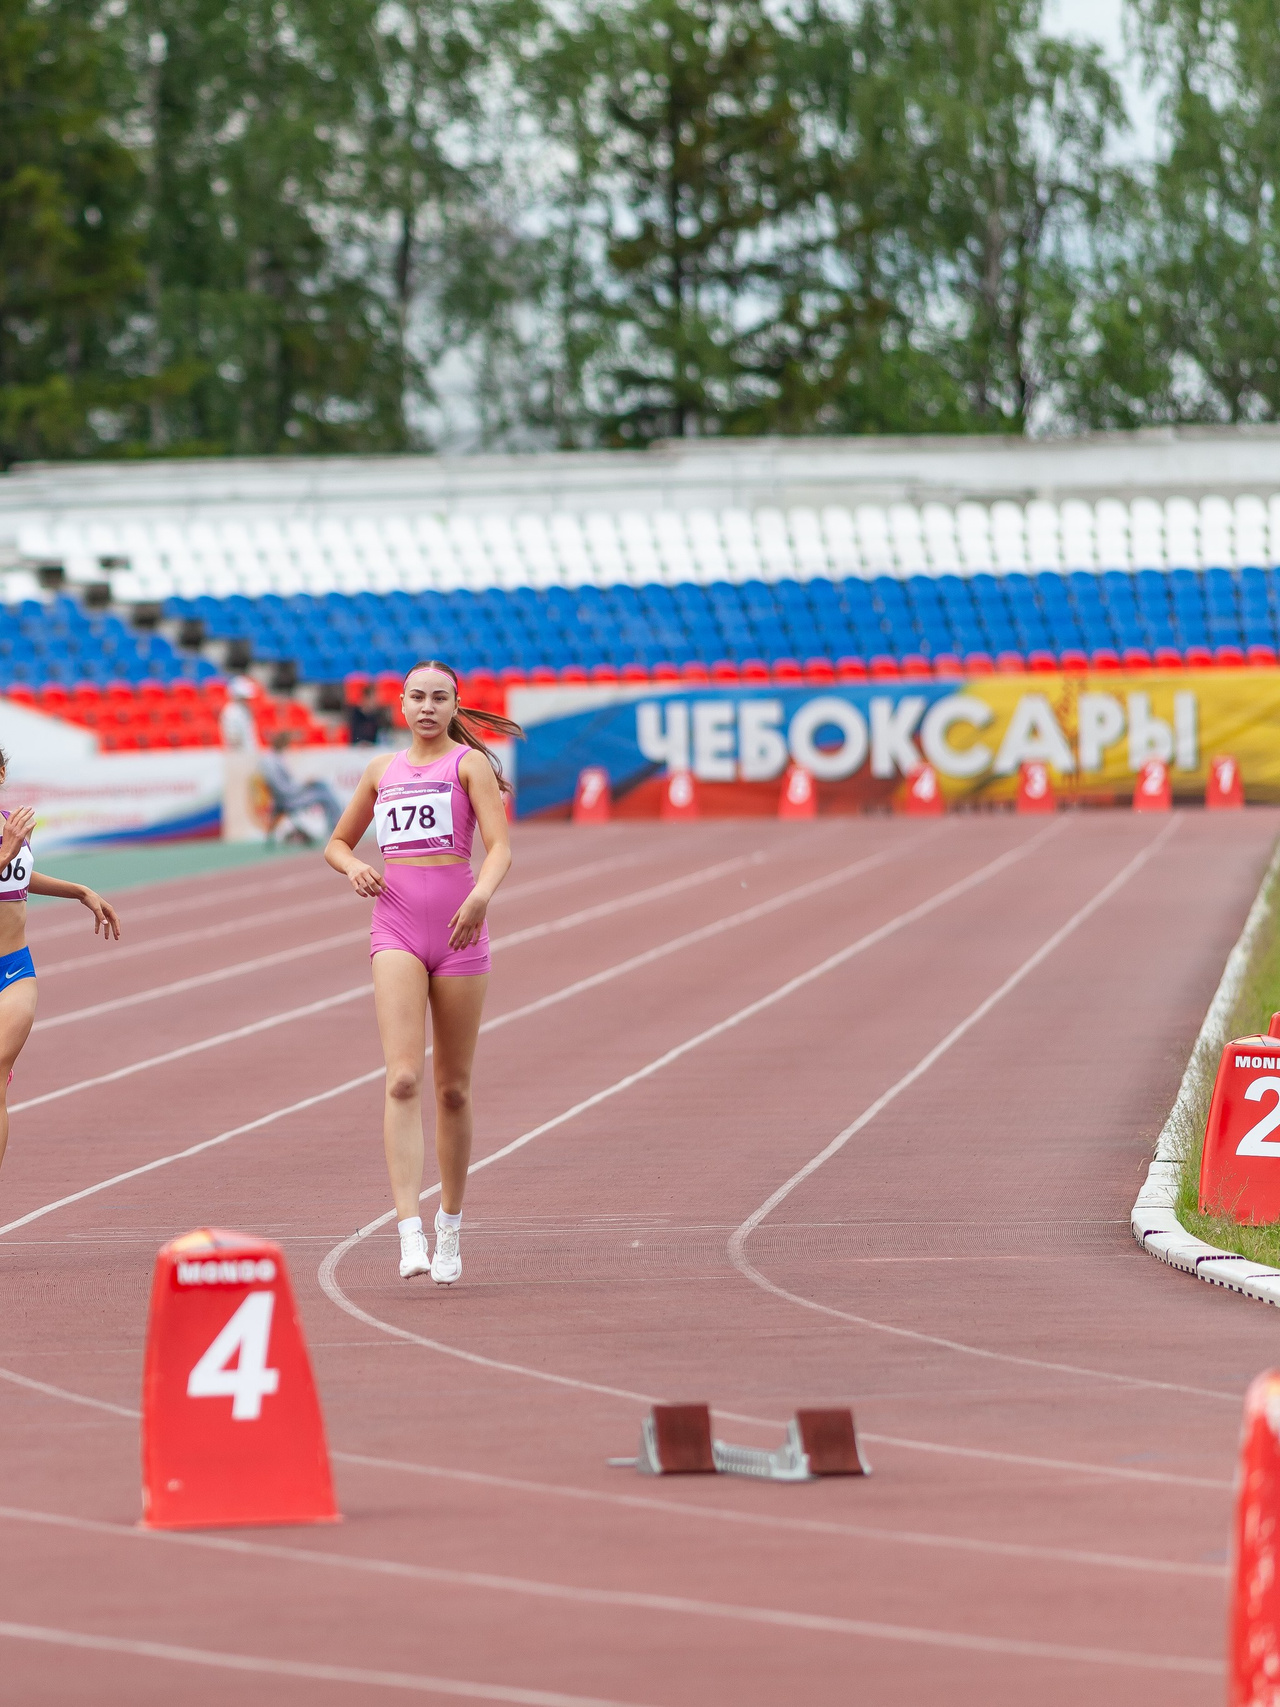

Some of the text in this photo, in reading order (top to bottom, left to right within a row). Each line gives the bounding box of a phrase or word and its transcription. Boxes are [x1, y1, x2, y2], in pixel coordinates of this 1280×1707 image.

[635, 689, 1198, 782] ЧЕБОКСАРЫ
[1024, 765, 1049, 800] 3
[387, 805, 436, 832] 178
[1234, 1055, 1280, 1069] MON
[1235, 1075, 1280, 1158] 2
[176, 1257, 277, 1286] MONDO
[186, 1289, 280, 1421] 4
